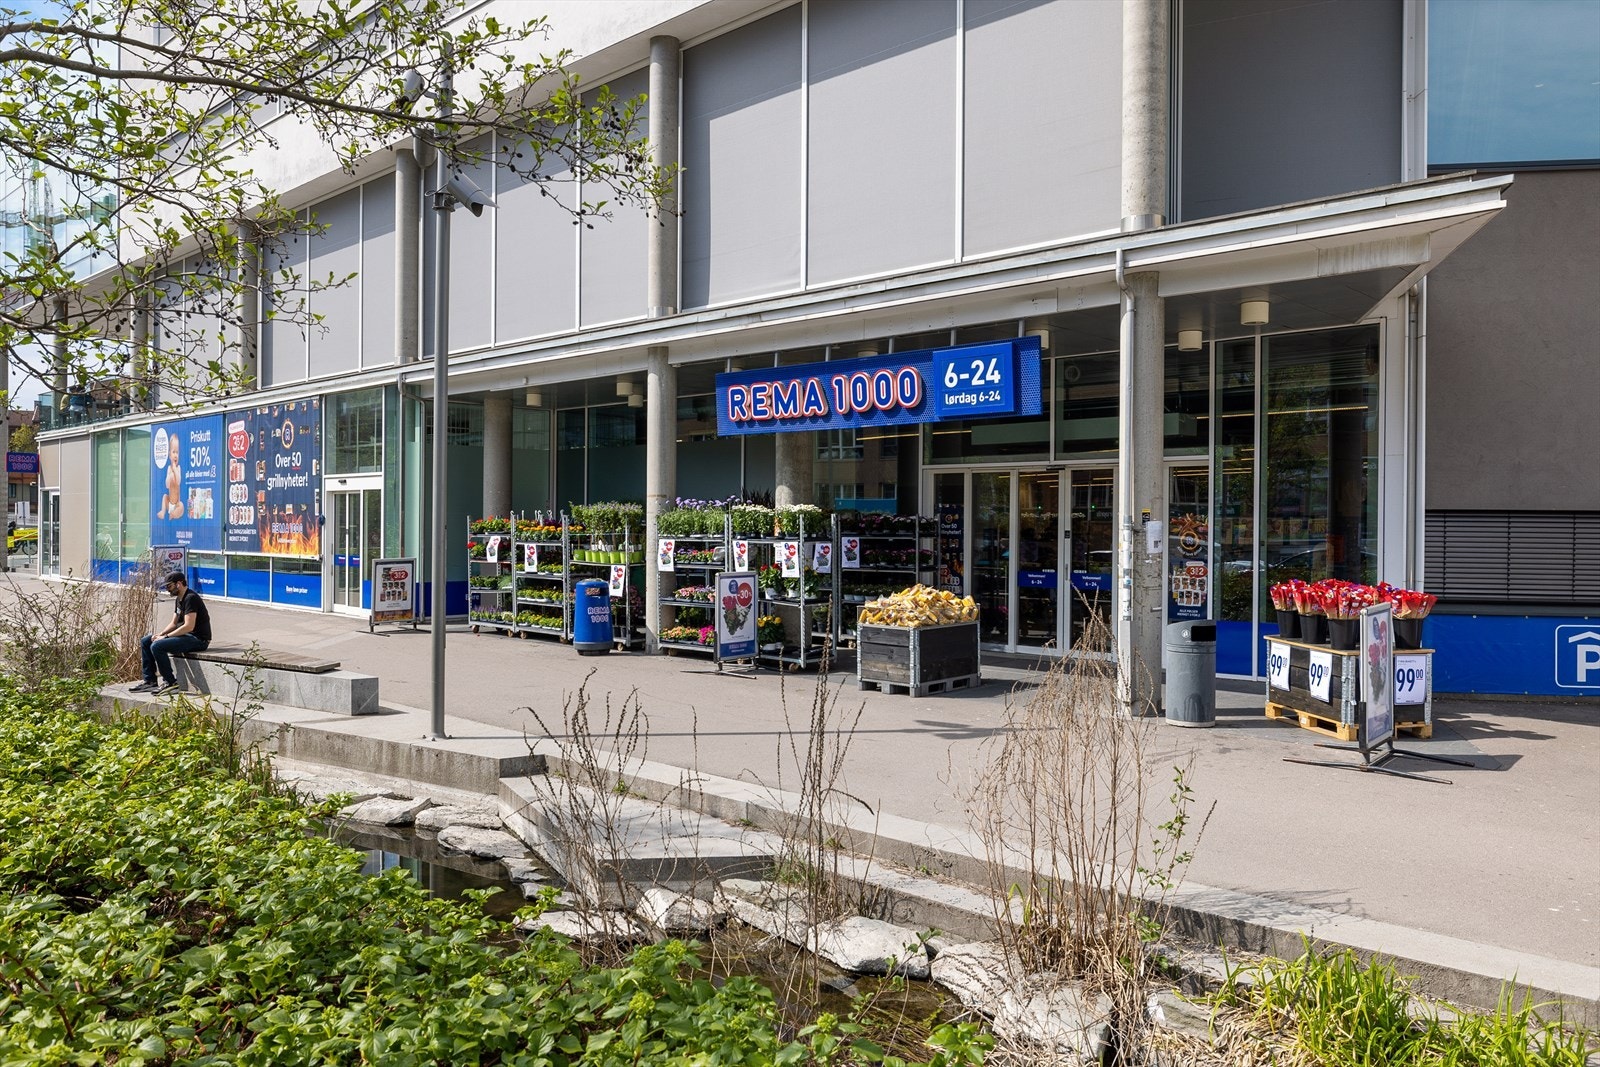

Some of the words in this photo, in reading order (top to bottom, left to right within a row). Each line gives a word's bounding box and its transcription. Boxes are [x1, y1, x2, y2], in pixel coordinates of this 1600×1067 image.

[944, 358, 1001, 388] 6-24
[728, 377, 829, 422] REMA
[832, 366, 922, 415] 1000
[945, 392, 977, 405] lørdag
[979, 390, 1001, 402] 6-24
[190, 430, 211, 443] Priskutt
[8, 454, 37, 463] REMA
[12, 462, 34, 471] 1000
[190, 446, 211, 468] 50%
[275, 453, 291, 468] Over
[291, 451, 302, 467] 50
[267, 472, 309, 491] grillnyheter!
[1190, 567, 1195, 576] 3
[1198, 567, 1204, 576] 2
[1271, 654, 1283, 677] 99
[1577, 644, 1600, 682] P
[1310, 662, 1323, 687] 99
[1396, 668, 1415, 692] 99
[1416, 669, 1424, 679] 00
